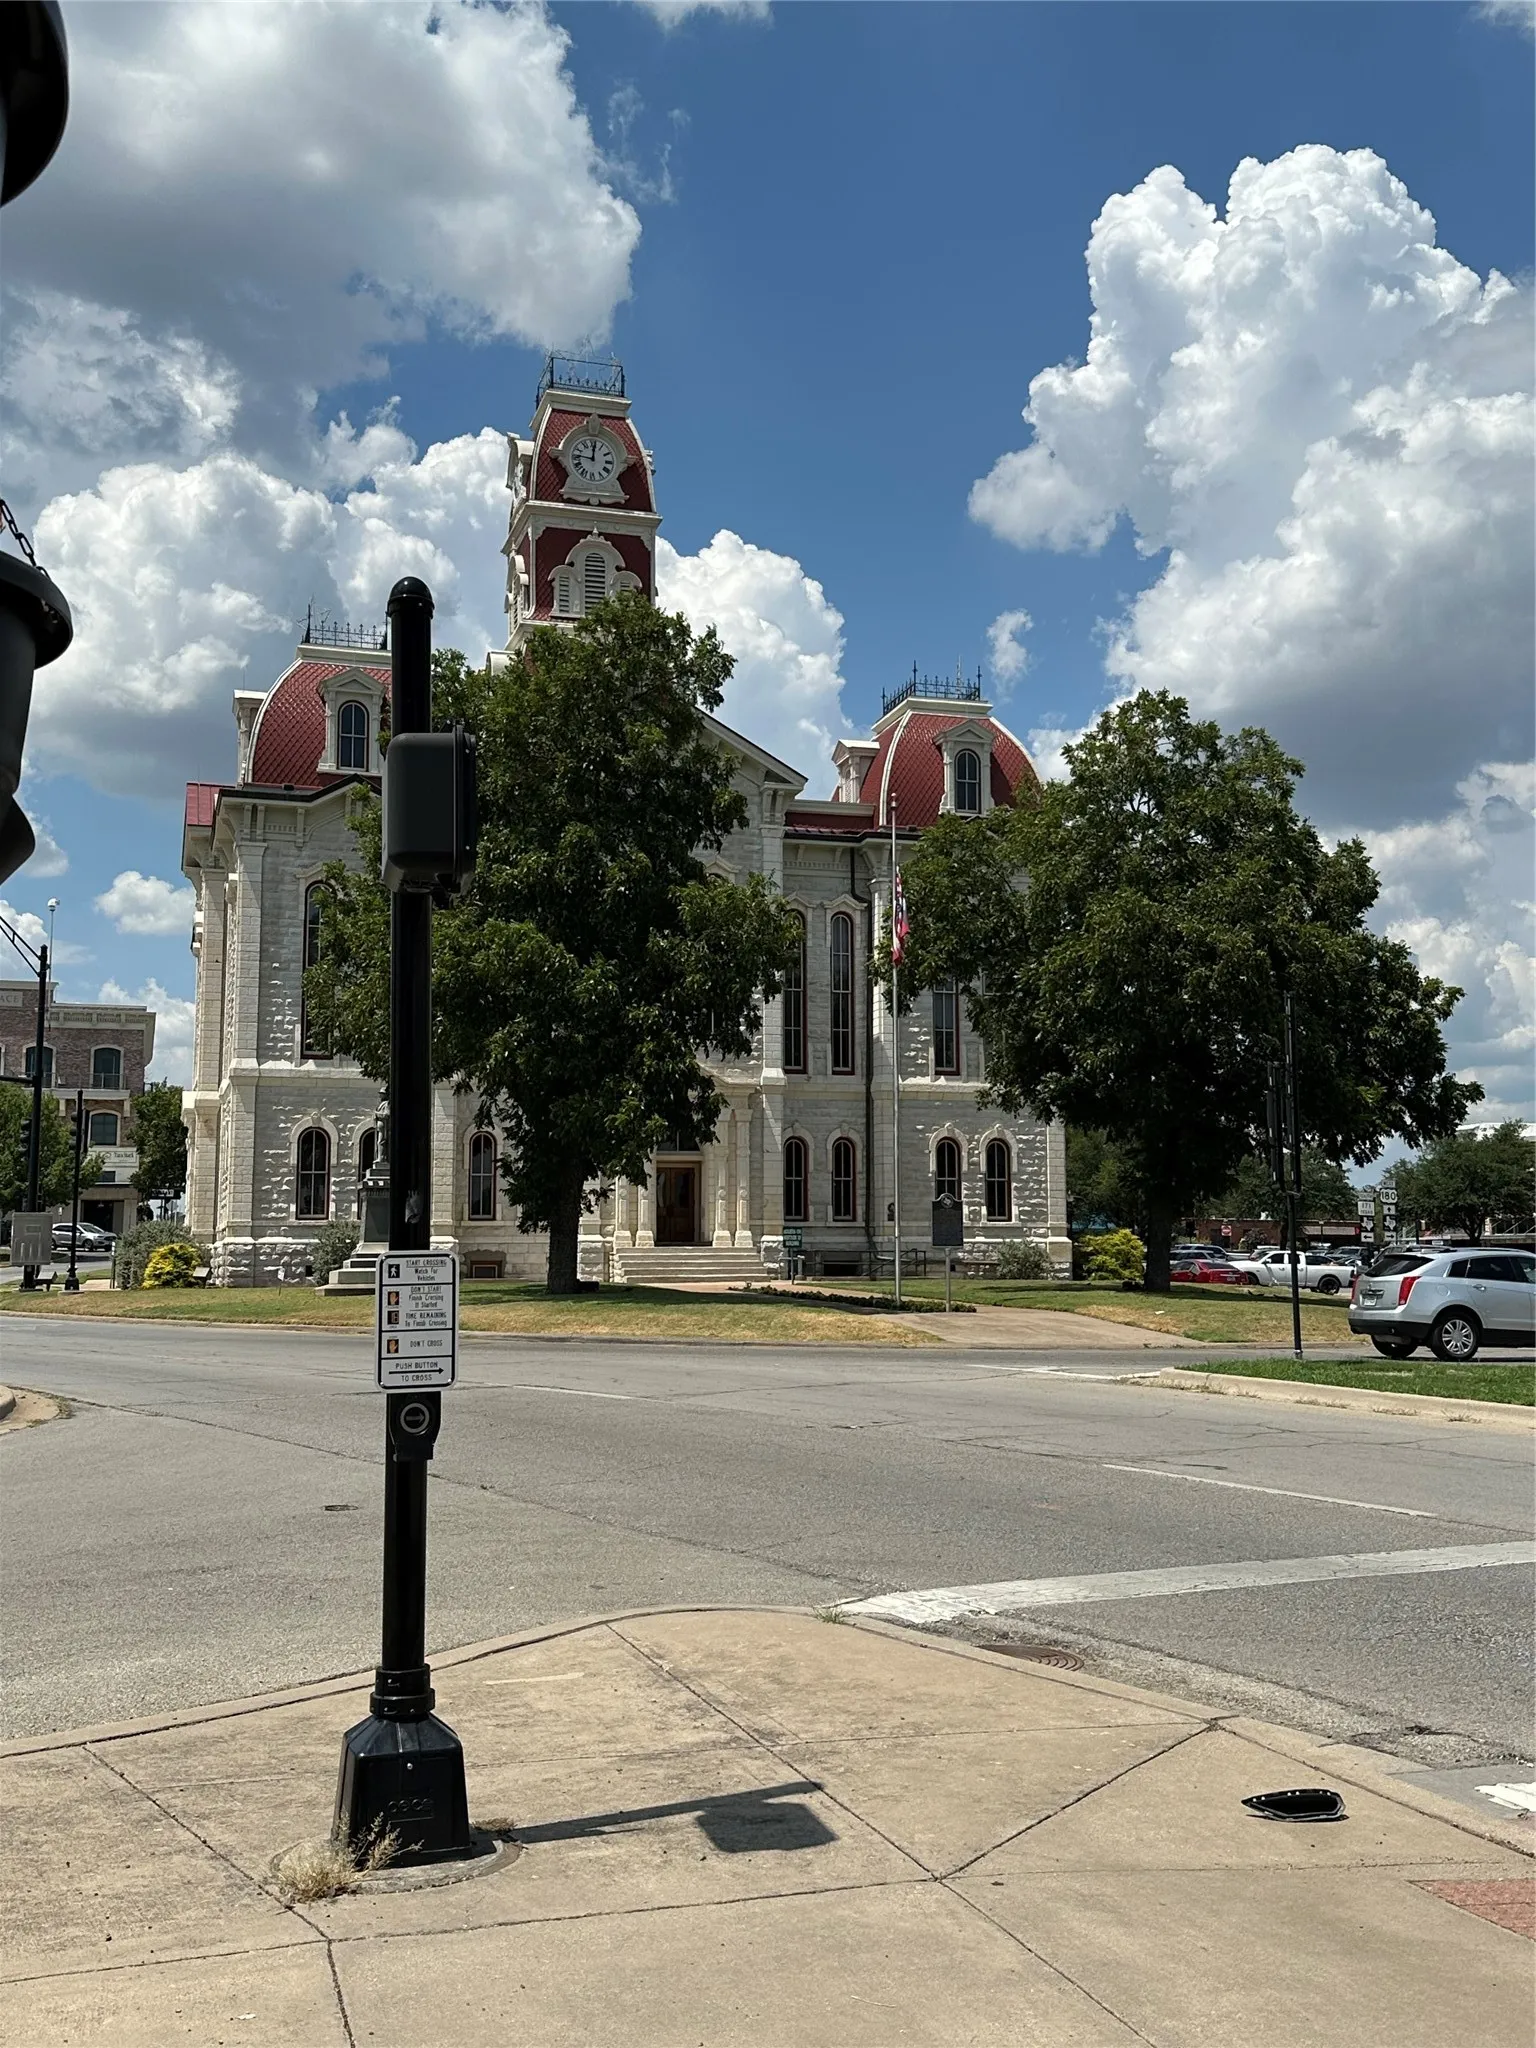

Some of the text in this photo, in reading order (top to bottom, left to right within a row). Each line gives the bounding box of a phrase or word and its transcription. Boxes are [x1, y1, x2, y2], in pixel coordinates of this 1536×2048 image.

[1381, 1191, 1396, 1201] 180
[425, 1294, 444, 1302] Crossing
[410, 1339, 443, 1348] DON'T CROSS
[414, 1361, 438, 1369] BUTTON
